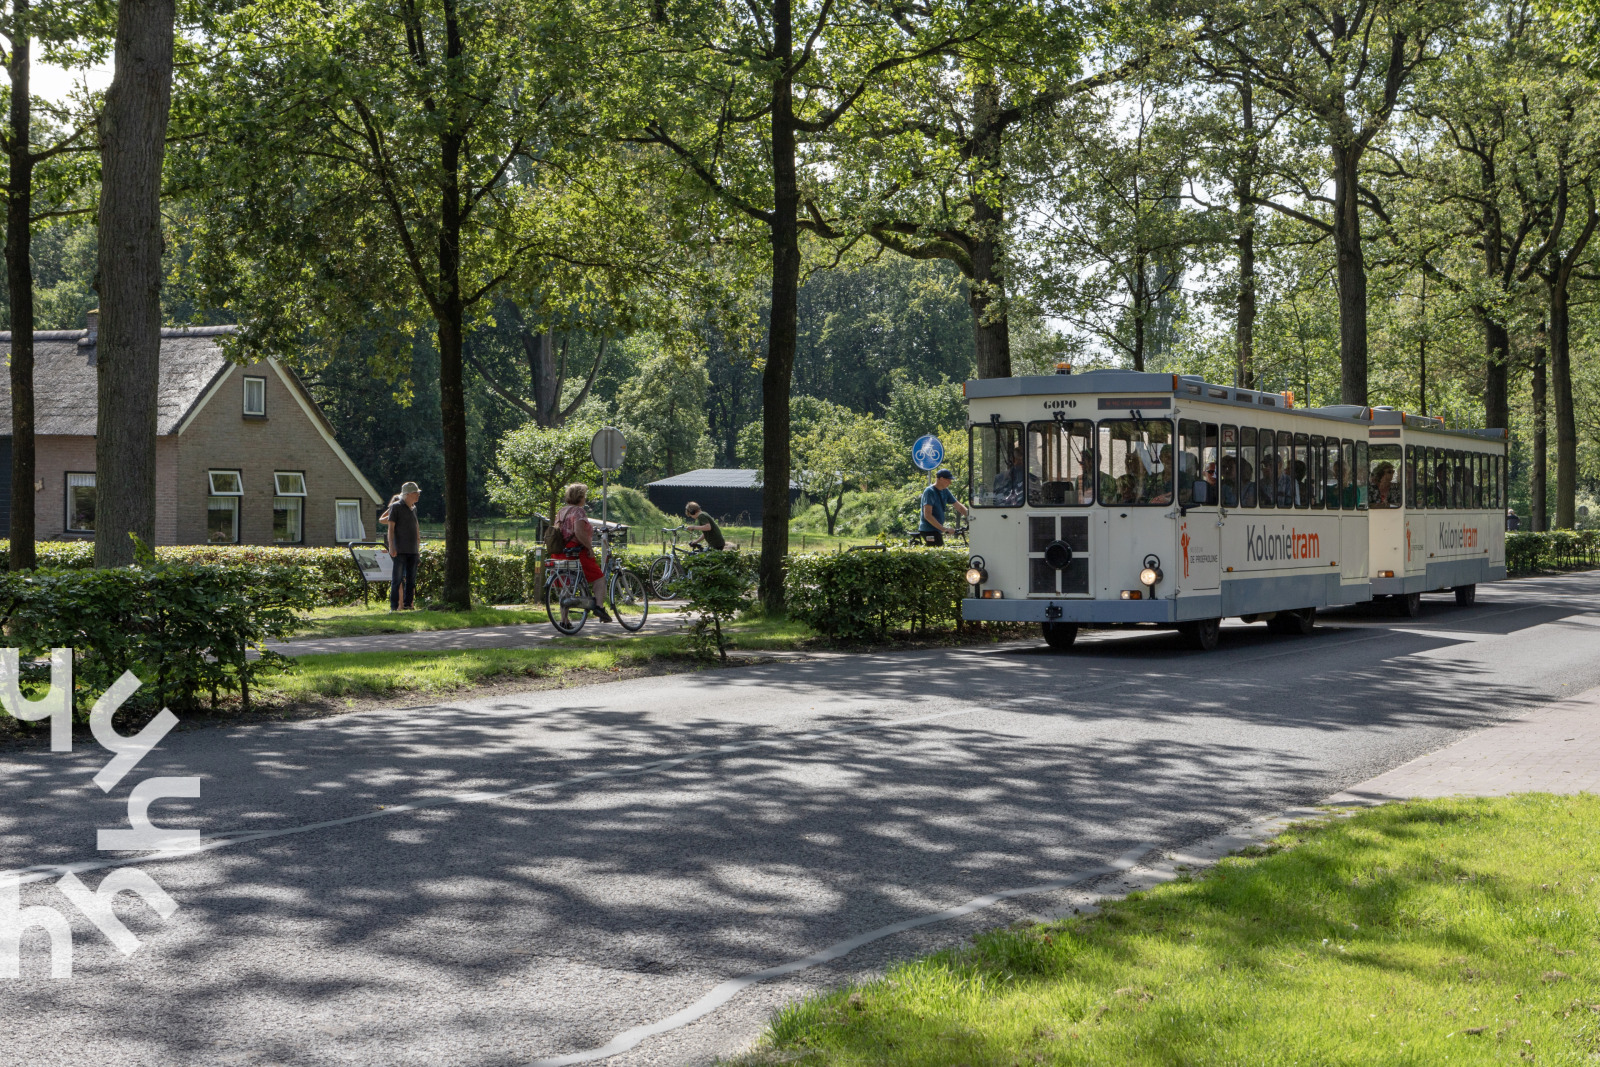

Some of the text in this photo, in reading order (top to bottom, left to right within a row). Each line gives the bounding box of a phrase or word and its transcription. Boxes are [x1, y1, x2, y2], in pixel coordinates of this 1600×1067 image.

[1043, 400, 1077, 410] GOPO
[1224, 430, 1234, 442] R
[1246, 524, 1320, 562] Kolonietram
[1440, 521, 1477, 550] Kolonietram
